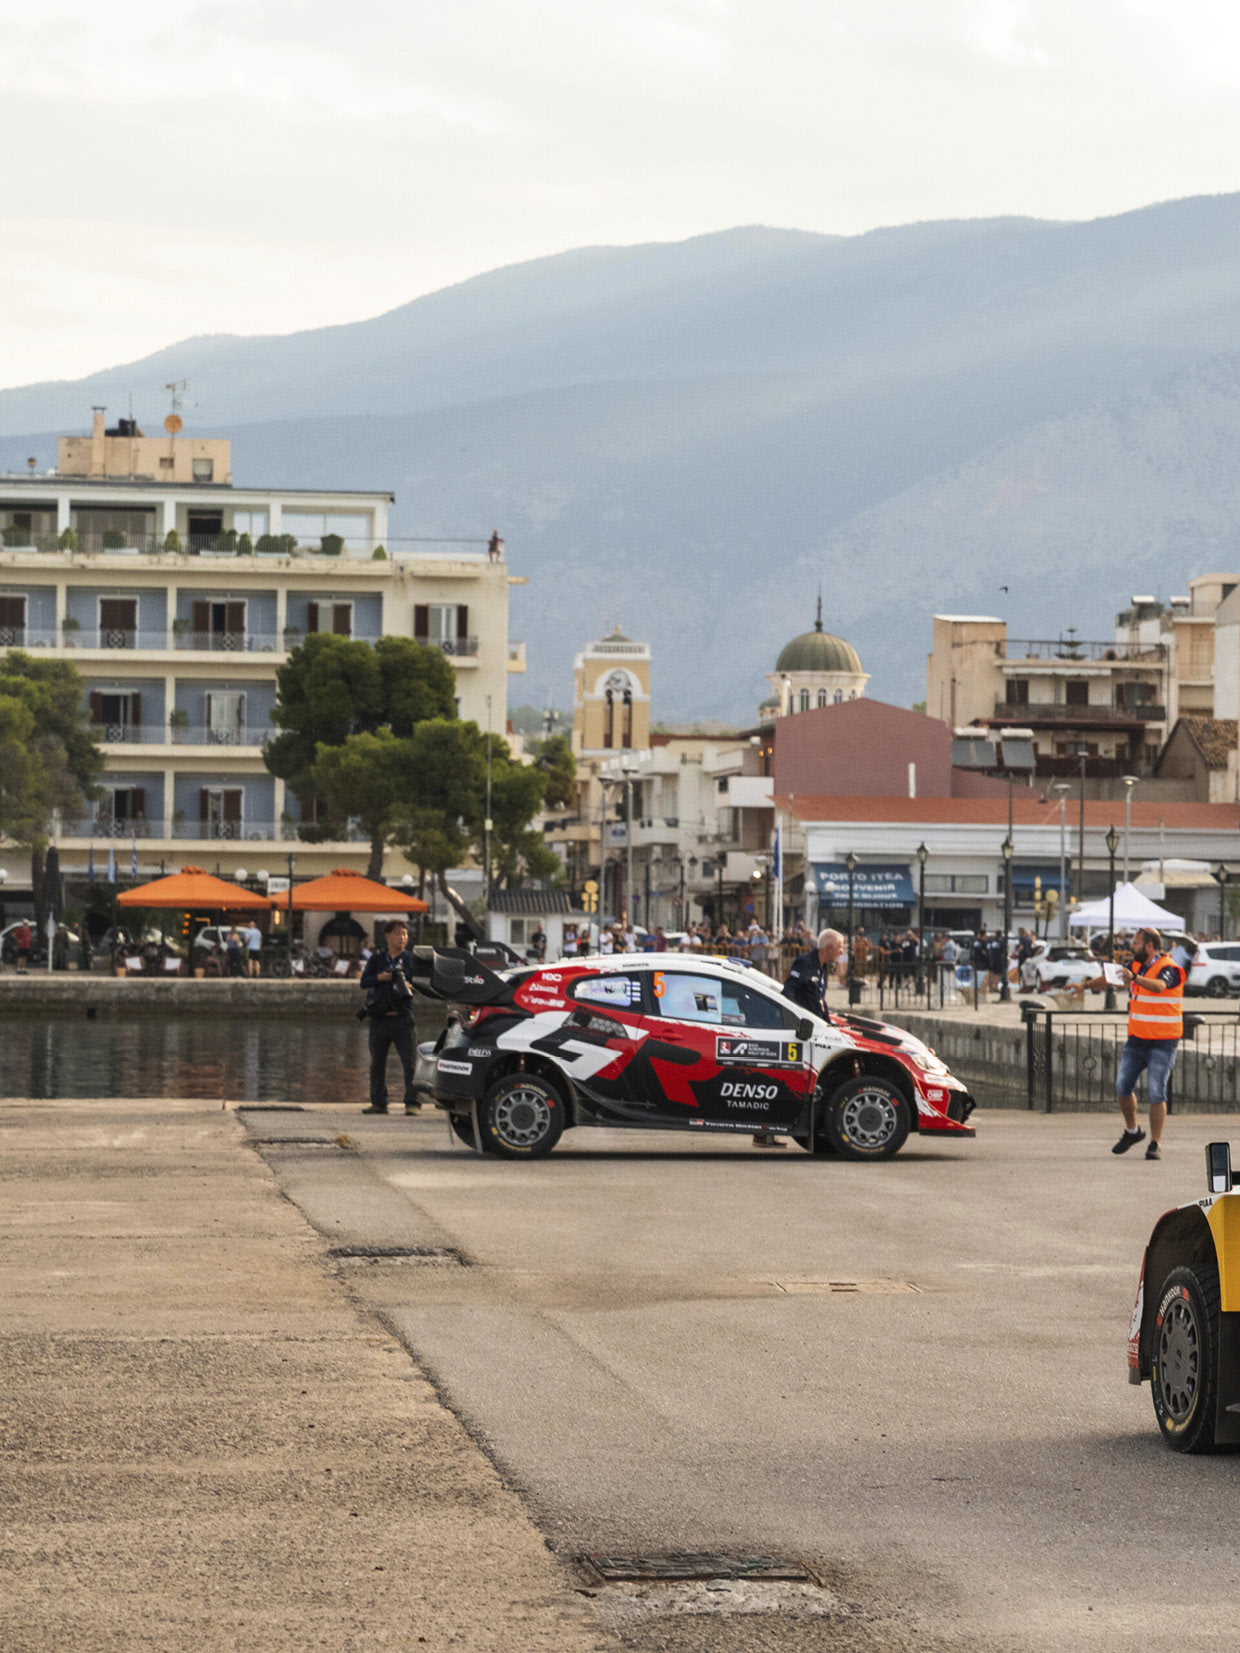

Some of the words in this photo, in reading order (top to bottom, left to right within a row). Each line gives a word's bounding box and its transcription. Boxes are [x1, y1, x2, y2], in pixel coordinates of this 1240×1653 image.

[653, 972, 666, 998] 5
[787, 1042, 797, 1061] 5
[720, 1082, 778, 1100] DENSO
[727, 1100, 769, 1110] TAMADIC
[1199, 1198, 1213, 1208] PIAA
